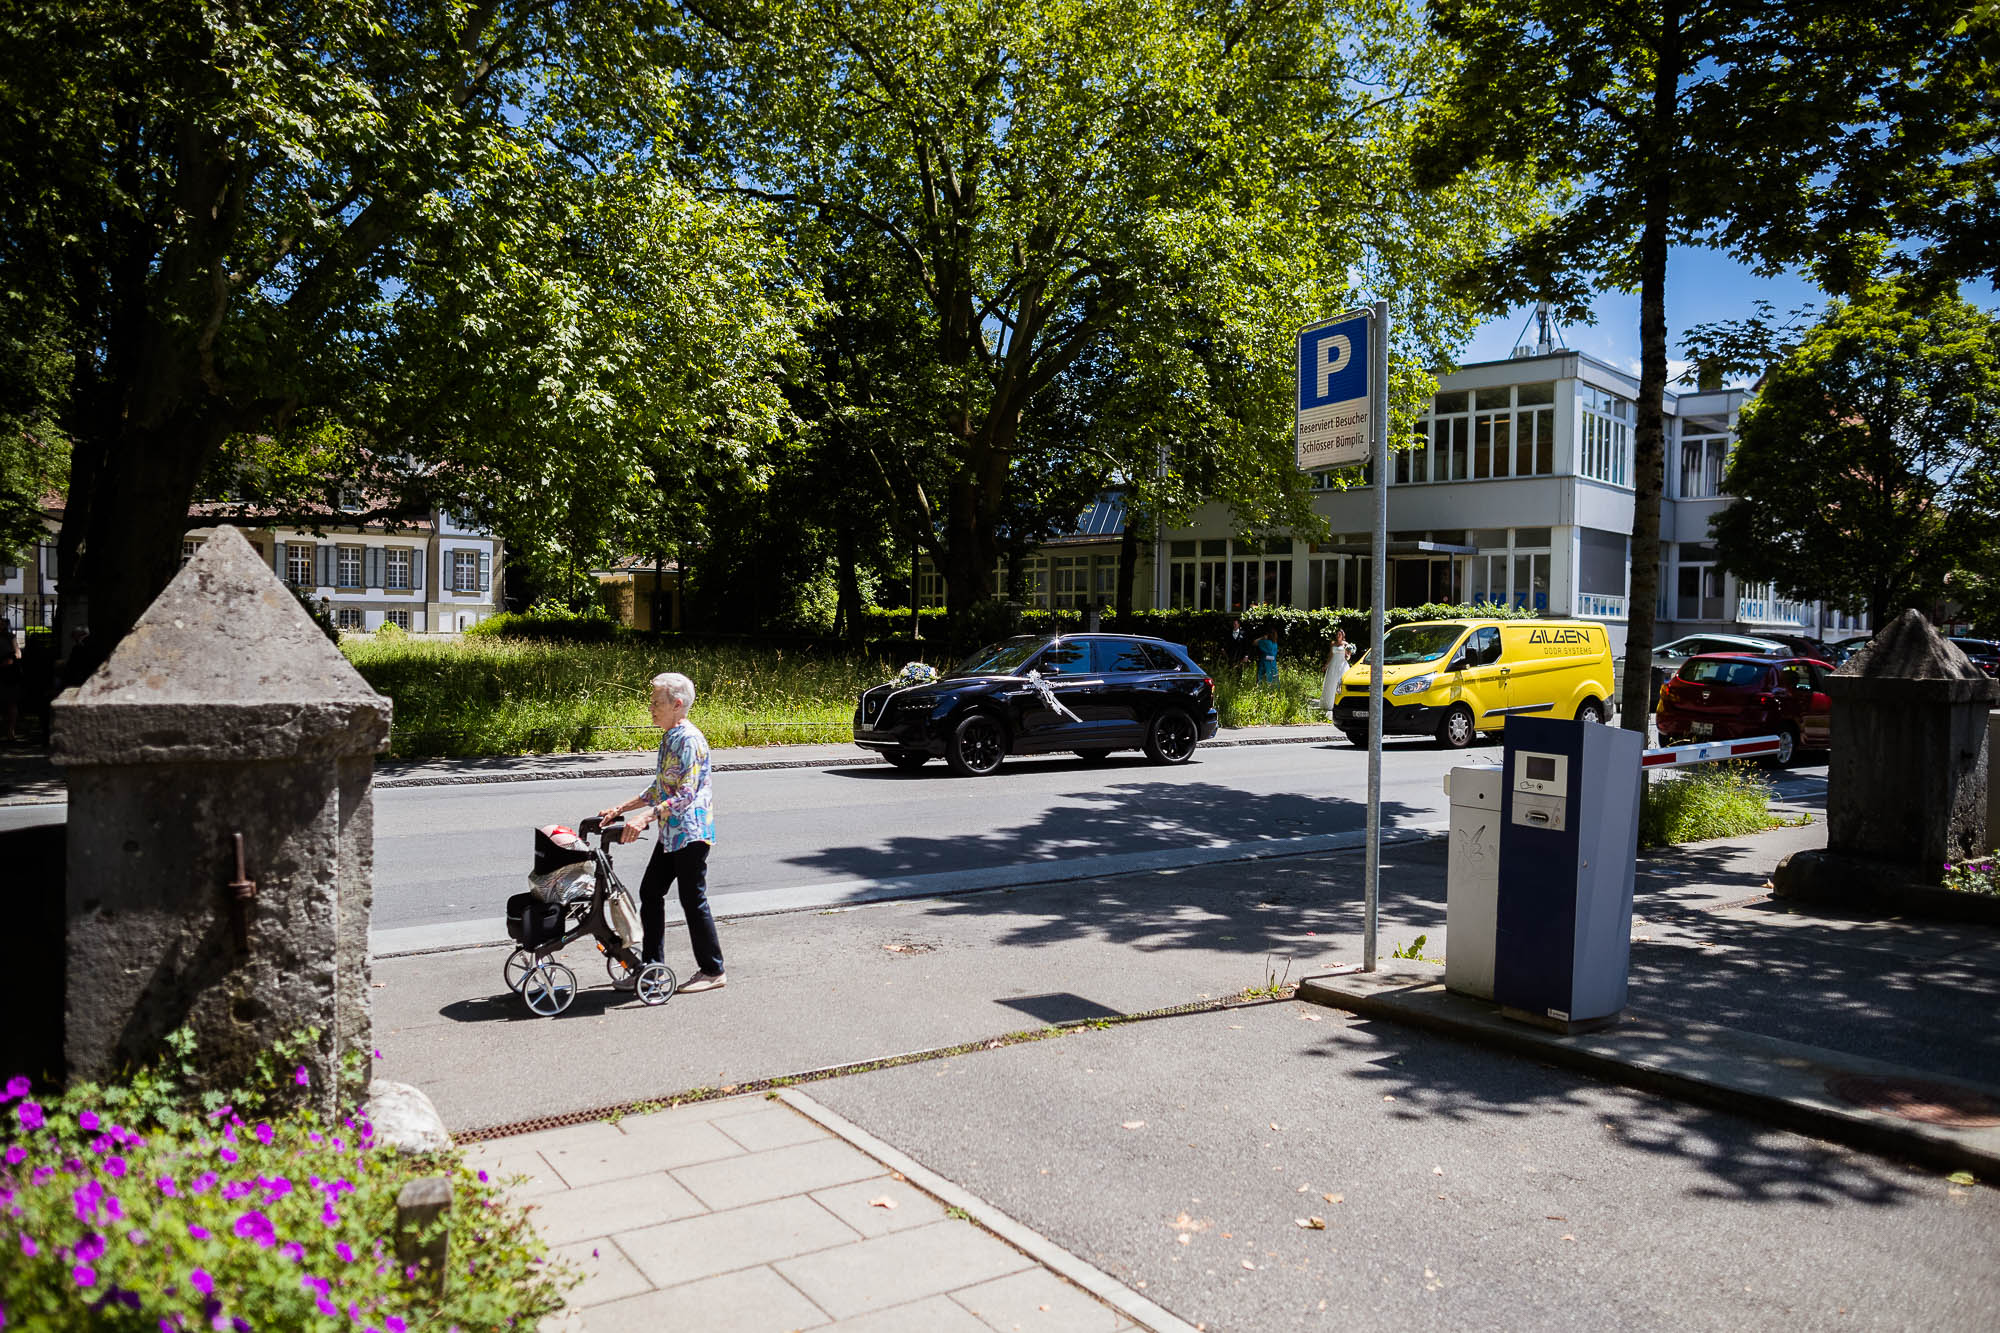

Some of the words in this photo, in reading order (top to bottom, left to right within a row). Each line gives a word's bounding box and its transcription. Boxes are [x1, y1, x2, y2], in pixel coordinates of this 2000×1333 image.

[1317, 335, 1351, 398] P
[1299, 418, 1334, 434] Reserviert
[1335, 412, 1368, 428] Besucher
[1302, 439, 1333, 454] Schlösser
[1335, 432, 1364, 448] Bümpliz
[1529, 629, 1590, 644] GILGEN
[1544, 647, 1562, 655] DOOR
[1564, 647, 1592, 655] SYSTEMS
